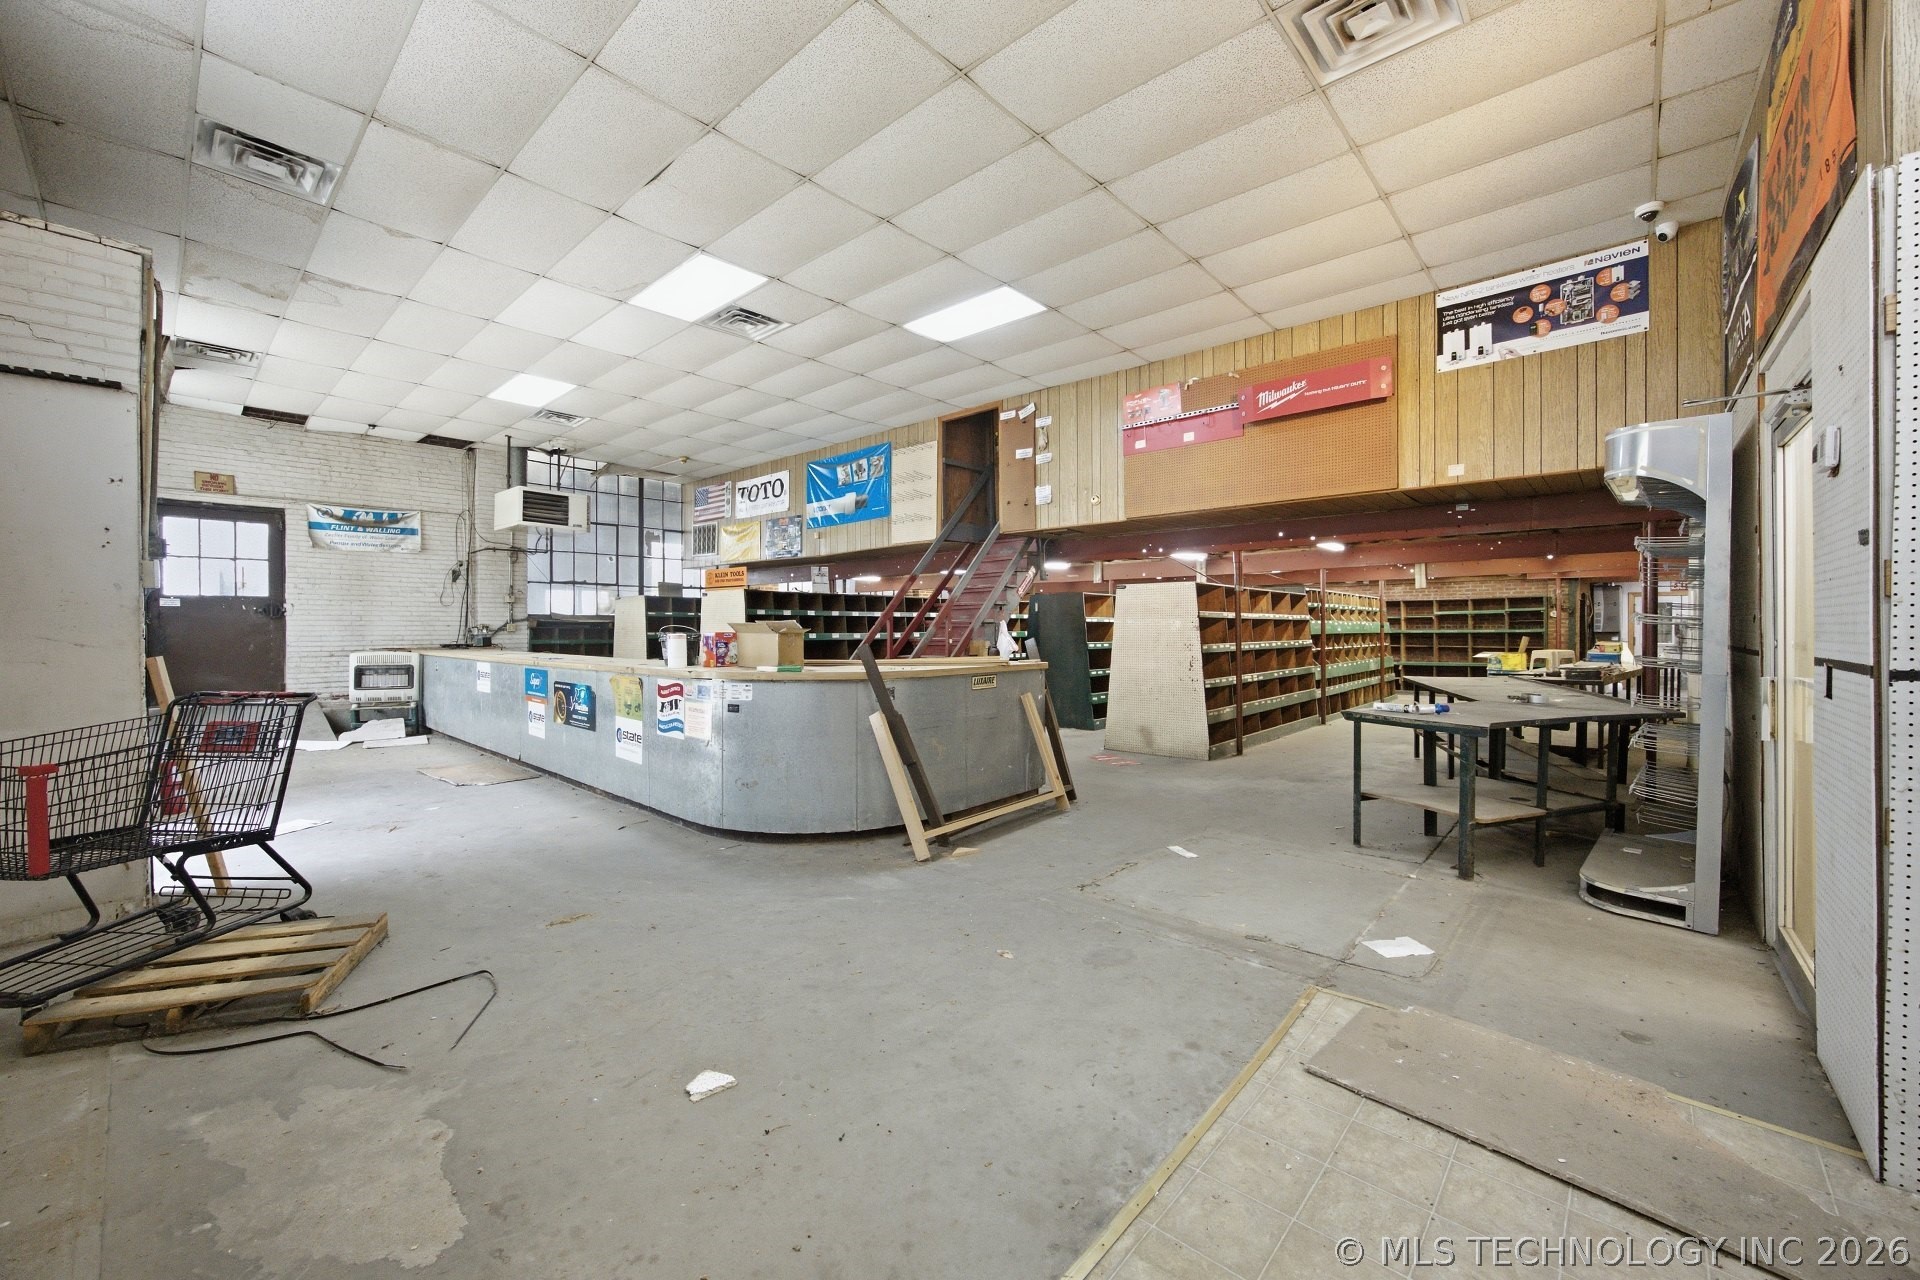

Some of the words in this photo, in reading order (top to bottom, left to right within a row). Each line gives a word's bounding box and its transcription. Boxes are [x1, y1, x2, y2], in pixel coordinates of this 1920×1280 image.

[1487, 296, 1515, 306] efficiency
[1453, 317, 1463, 325] got
[1256, 379, 1307, 408] Milwaukee
[737, 478, 785, 503] TOTO
[714, 571, 729, 579] KLEIN
[729, 570, 745, 578] TOOLS
[622, 730, 642, 744] state
